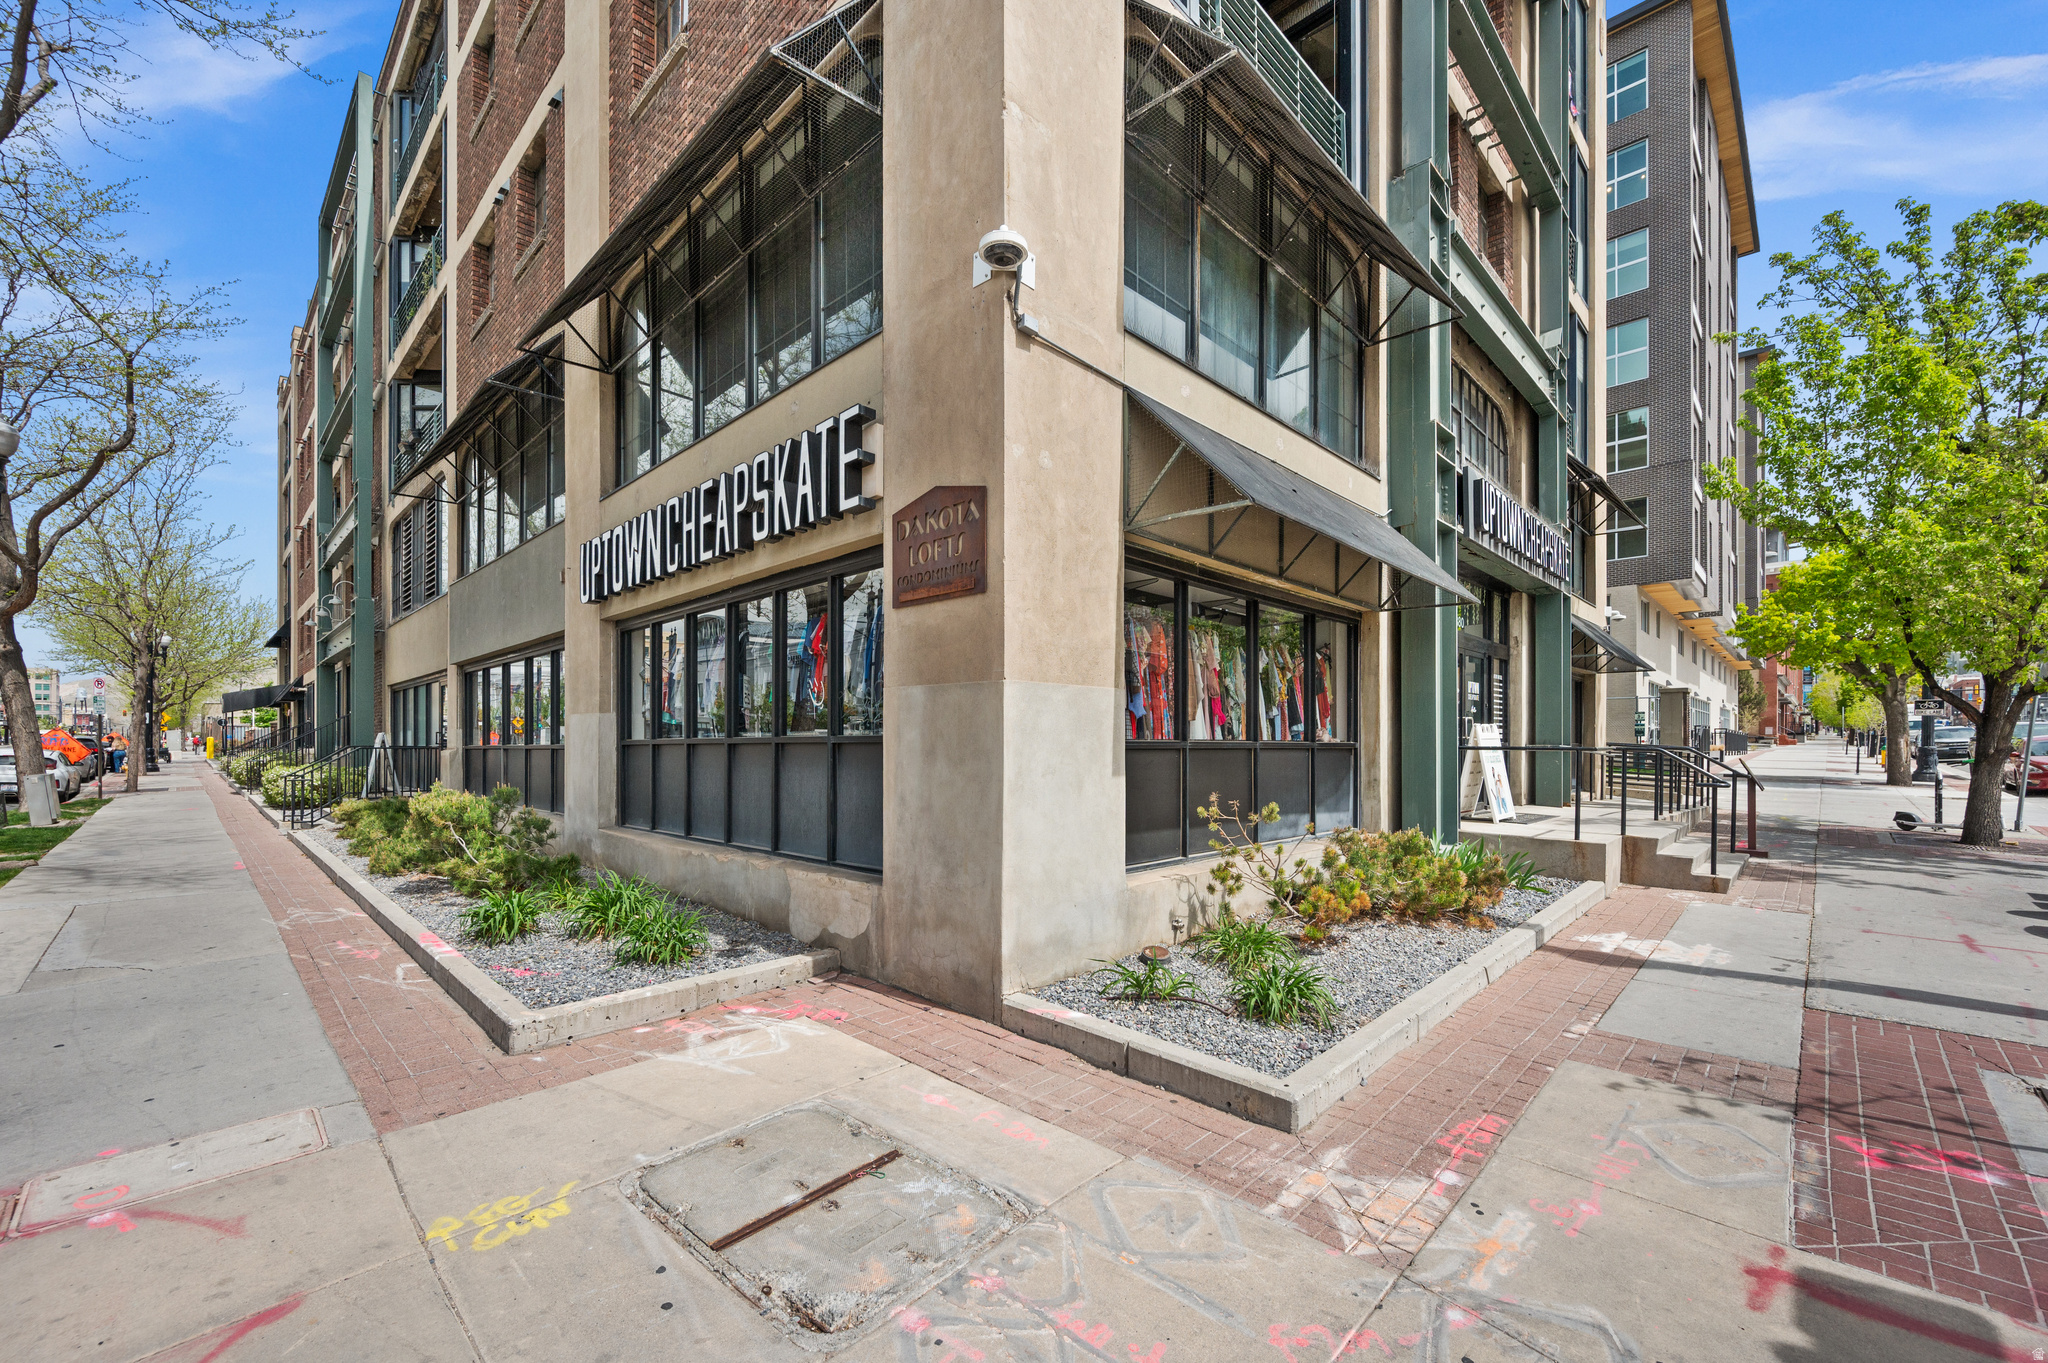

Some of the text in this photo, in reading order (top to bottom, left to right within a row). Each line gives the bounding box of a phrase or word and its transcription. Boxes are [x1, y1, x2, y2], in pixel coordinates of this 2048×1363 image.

[897, 498, 981, 542] DAKOTA
[908, 531, 966, 567] LOFTS
[897, 559, 980, 587] CONDOMINIUMS
